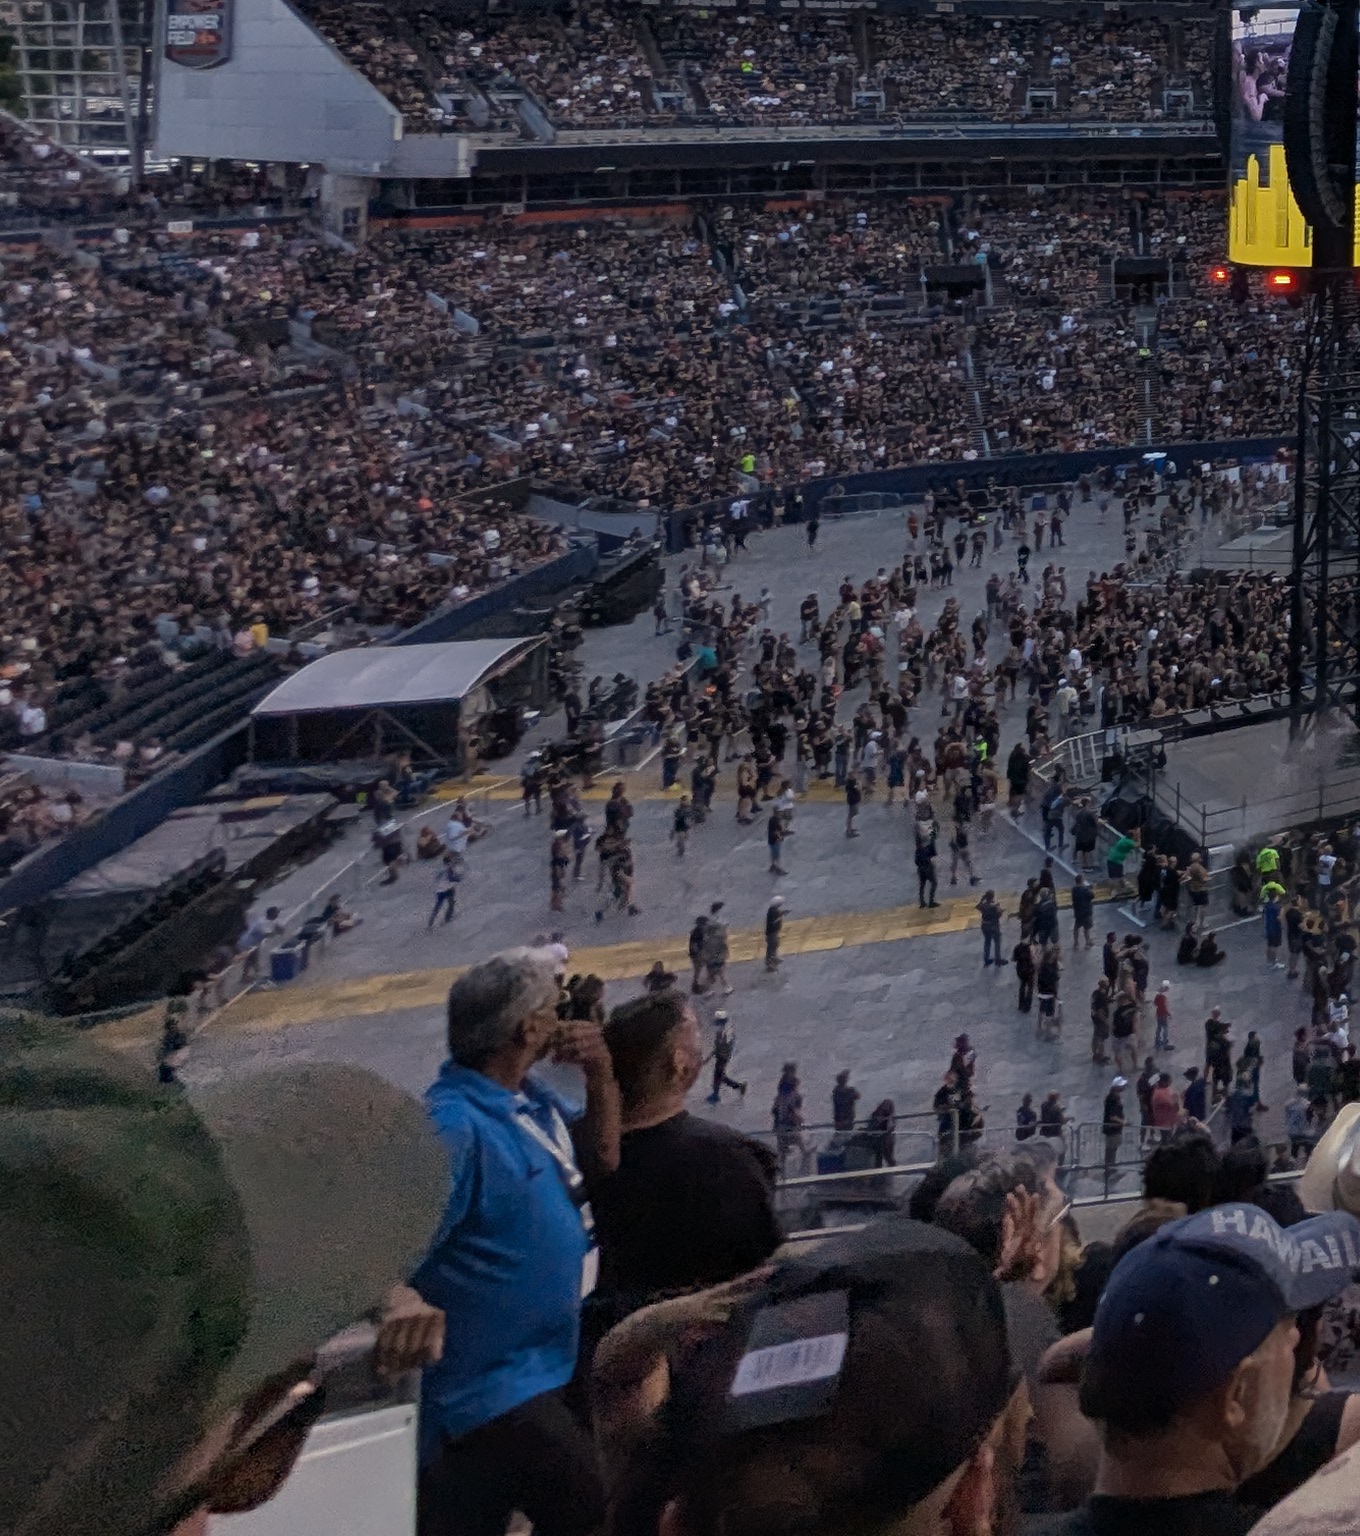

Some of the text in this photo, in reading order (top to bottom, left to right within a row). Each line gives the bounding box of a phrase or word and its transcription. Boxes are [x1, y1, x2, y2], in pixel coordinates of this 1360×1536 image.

[168, 14, 219, 30] EMPOWER
[167, 30, 196, 45] FIELD
[1210, 1208, 1360, 1274] HAWAII
